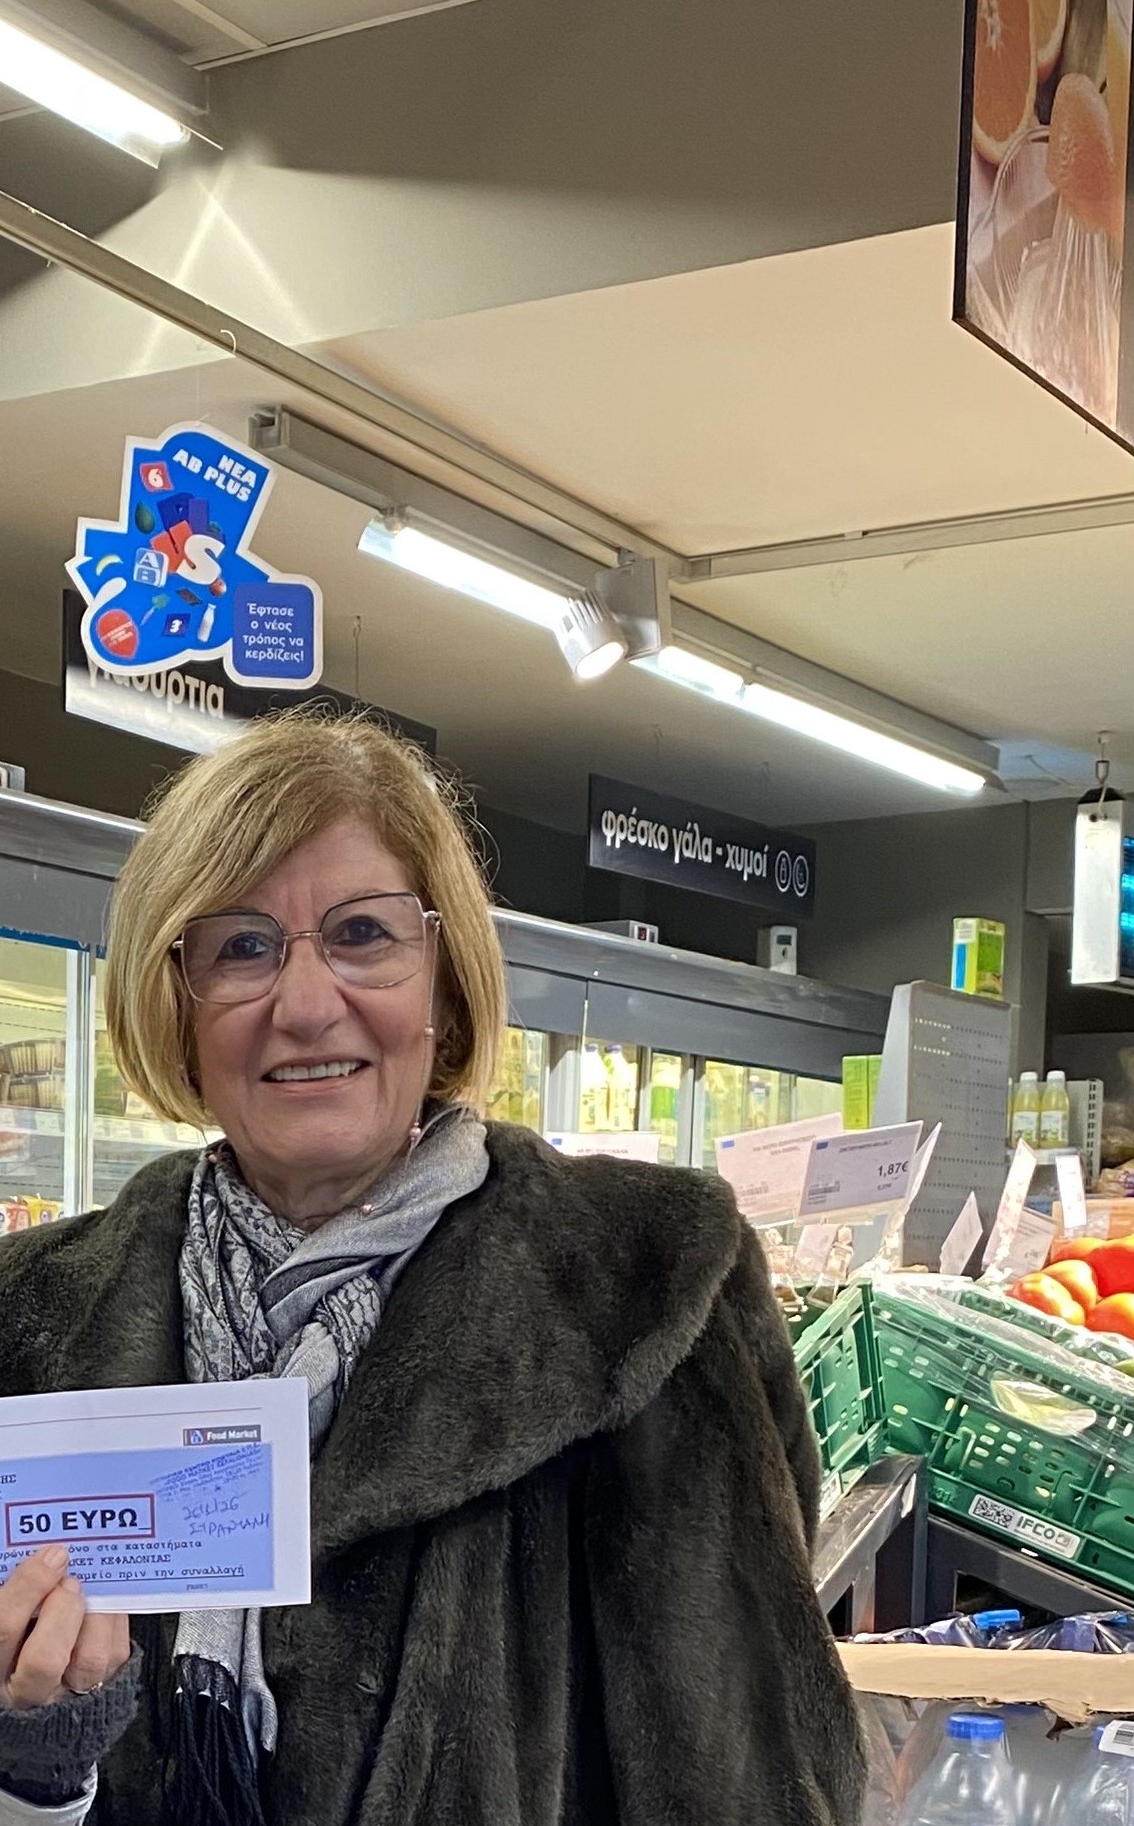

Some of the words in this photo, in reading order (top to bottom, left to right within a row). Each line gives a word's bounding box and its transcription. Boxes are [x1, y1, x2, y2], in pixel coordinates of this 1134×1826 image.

[172, 448, 204, 474] AB
[203, 465, 253, 503] PLUS
[217, 454, 257, 488] ΝΕΑ
[247, 602, 294, 618] Έφτασε
[250, 621, 259, 630] ο
[264, 618, 293, 633] νέος
[242, 633, 286, 648] τρόπος
[288, 636, 304, 646] να
[244, 648, 304, 664] κερδίζεις!
[601, 806, 669, 852] φρέσκο
[672, 821, 713, 864] γάλα
[725, 843, 769, 881] χυμοί
[206, 1431, 227, 1441] Food
[228, 1429, 258, 1440] Market
[19, 1513, 51, 1534] 50
[1017, 1515, 1056, 1540] IFCO
[67, 1543, 90, 1553] όνο
[96, 1543, 118, 1551] στα
[125, 1539, 203, 1552] καταστήματα
[100, 1553, 171, 1566] ΚΕΦΑΛΟΝΙΑΣ
[118, 1567, 148, 1578] πριν
[154, 1567, 175, 1577] την
[181, 1563, 244, 1577] συναλλαγή
